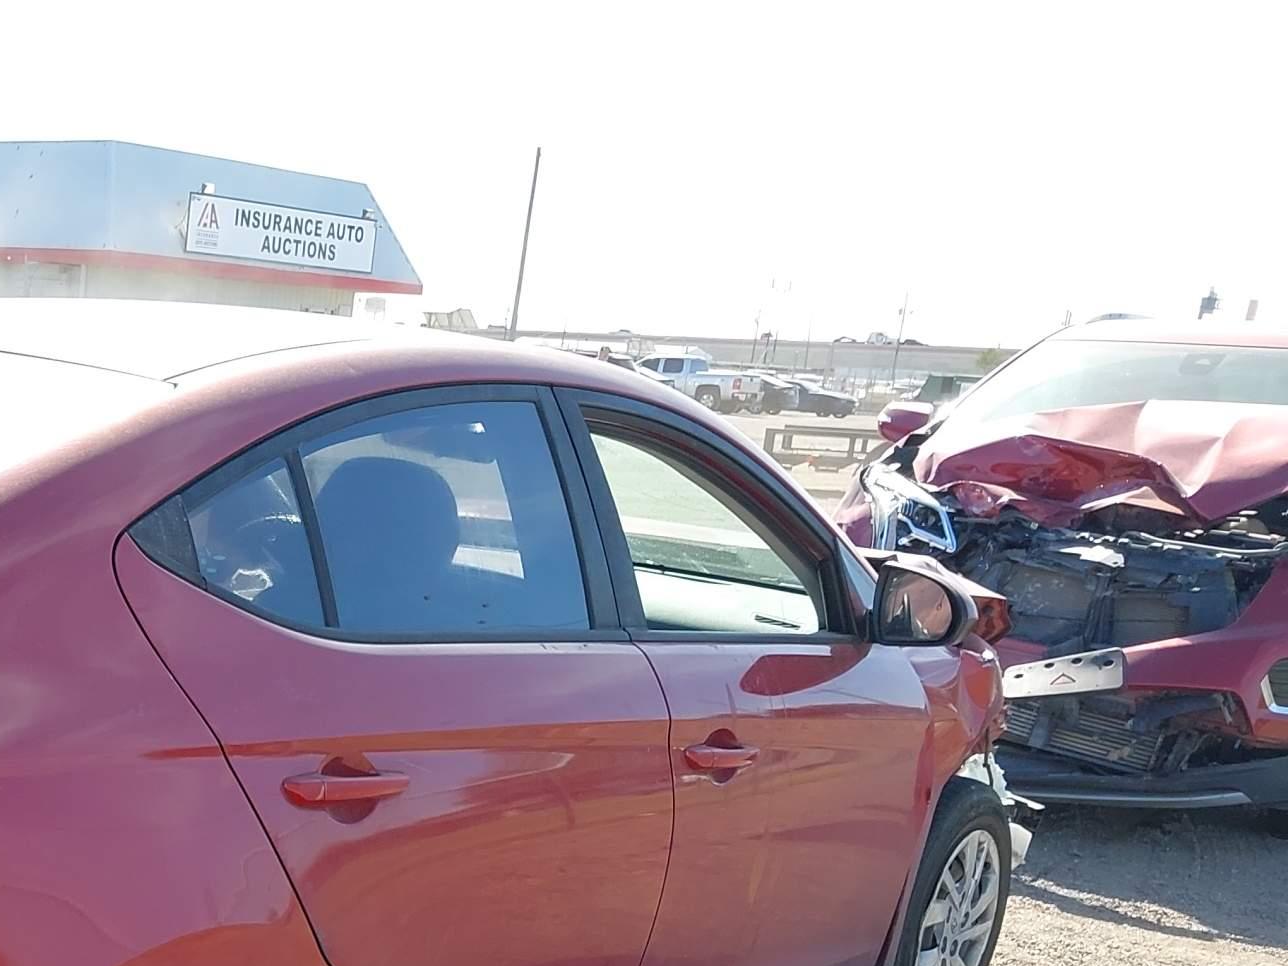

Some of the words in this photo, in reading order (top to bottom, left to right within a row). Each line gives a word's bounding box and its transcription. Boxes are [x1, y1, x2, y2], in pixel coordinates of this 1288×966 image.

[234, 207, 324, 238] INSURANCE
[326, 221, 365, 243] AUTO
[260, 235, 337, 262] AUCTIONS
